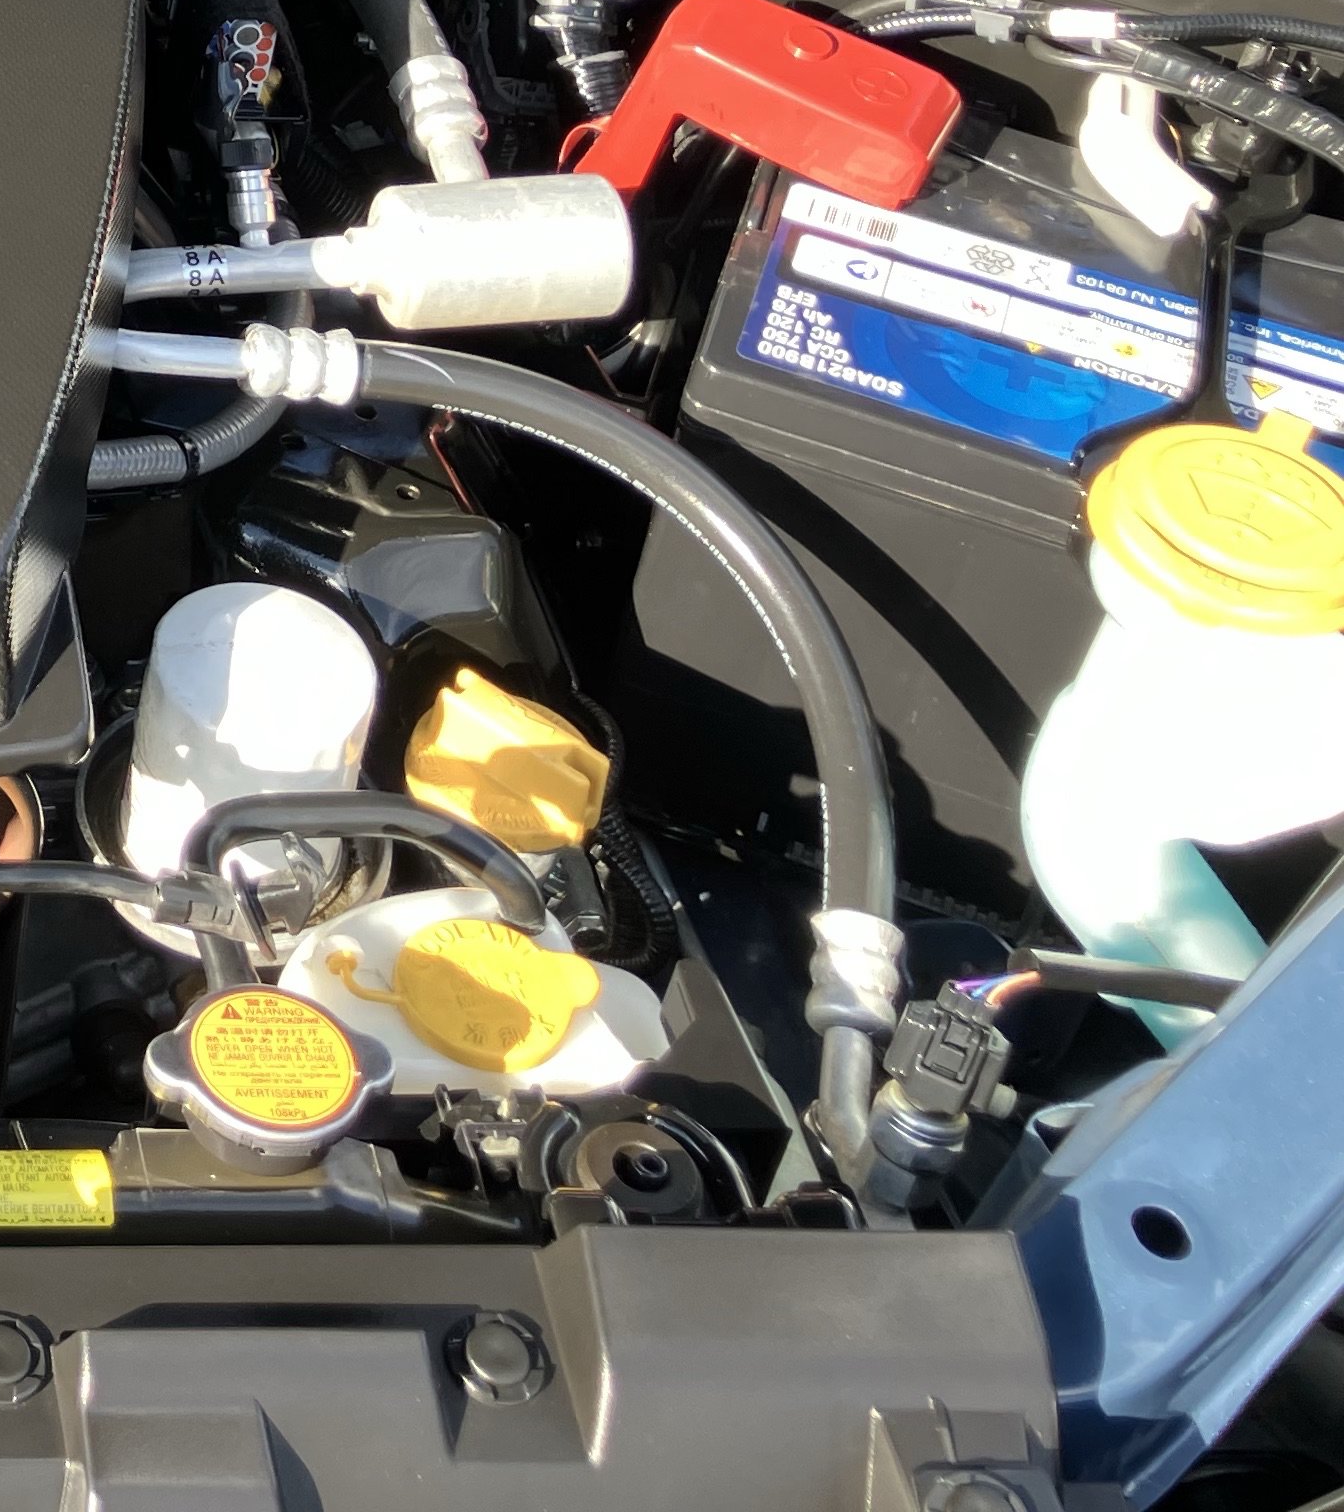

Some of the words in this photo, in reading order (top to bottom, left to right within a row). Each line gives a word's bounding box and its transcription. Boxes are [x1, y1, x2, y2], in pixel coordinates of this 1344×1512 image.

[776, 284, 817, 308] EFB
[1076, 274, 1126, 299] 08103
[771, 298, 797, 317] 76
[1132, 291, 1154, 306] NJ
[767, 312, 805, 334] 120
[802, 308, 833, 327] Ah
[762, 326, 800, 350] 750
[809, 326, 841, 347] RC
[1136, 324, 1165, 342] OPEN
[807, 339, 850, 364] CCA
[244, 1007, 304, 1017] WARNING
[206, 1044, 240, 1053] NEVER
[245, 1045, 273, 1053] OPEN
[278, 1045, 308, 1053] WHEN
[313, 1045, 333, 1053] HOT
[224, 1053, 256, 1061] JAMAIS
[235, 1088, 329, 1099] AVERTISSEMENT
[270, 1108, 307, 1119] 108kPa
